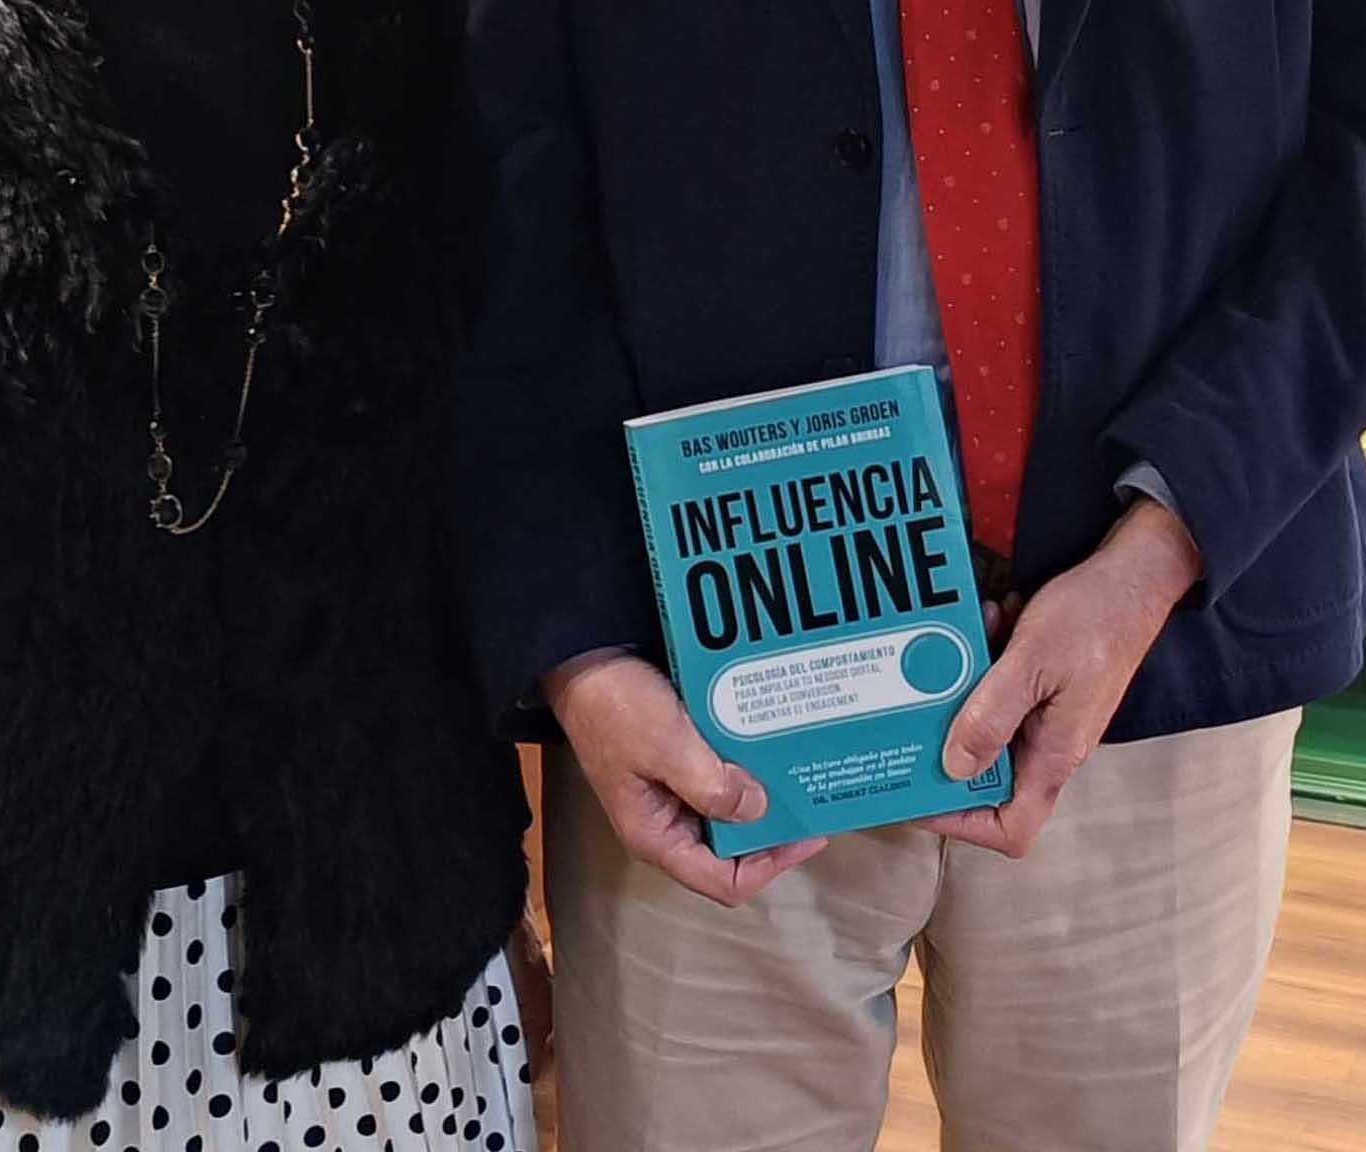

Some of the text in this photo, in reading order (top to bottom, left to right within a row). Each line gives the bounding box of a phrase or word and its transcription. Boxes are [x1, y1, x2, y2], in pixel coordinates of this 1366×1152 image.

[681, 399, 900, 458] BAS WOUTERS Y JORIS GROEN
[698, 425, 892, 474] CON LA COLABORACIÓN DE PILAR BRINGAS
[670, 455, 943, 559] INFLUENCIA
[685, 515, 961, 651] ONLINE
[731, 645, 896, 688] PSICOLOGÍA DEL COMPORTAMIENTO
[735, 687, 758, 700] PARA
[759, 679, 801, 696] IMPULSAR
[737, 697, 776, 713] MEJORAR
[748, 705, 793, 724] AUMENTAR
[805, 693, 860, 713] ENGAGEMENT
